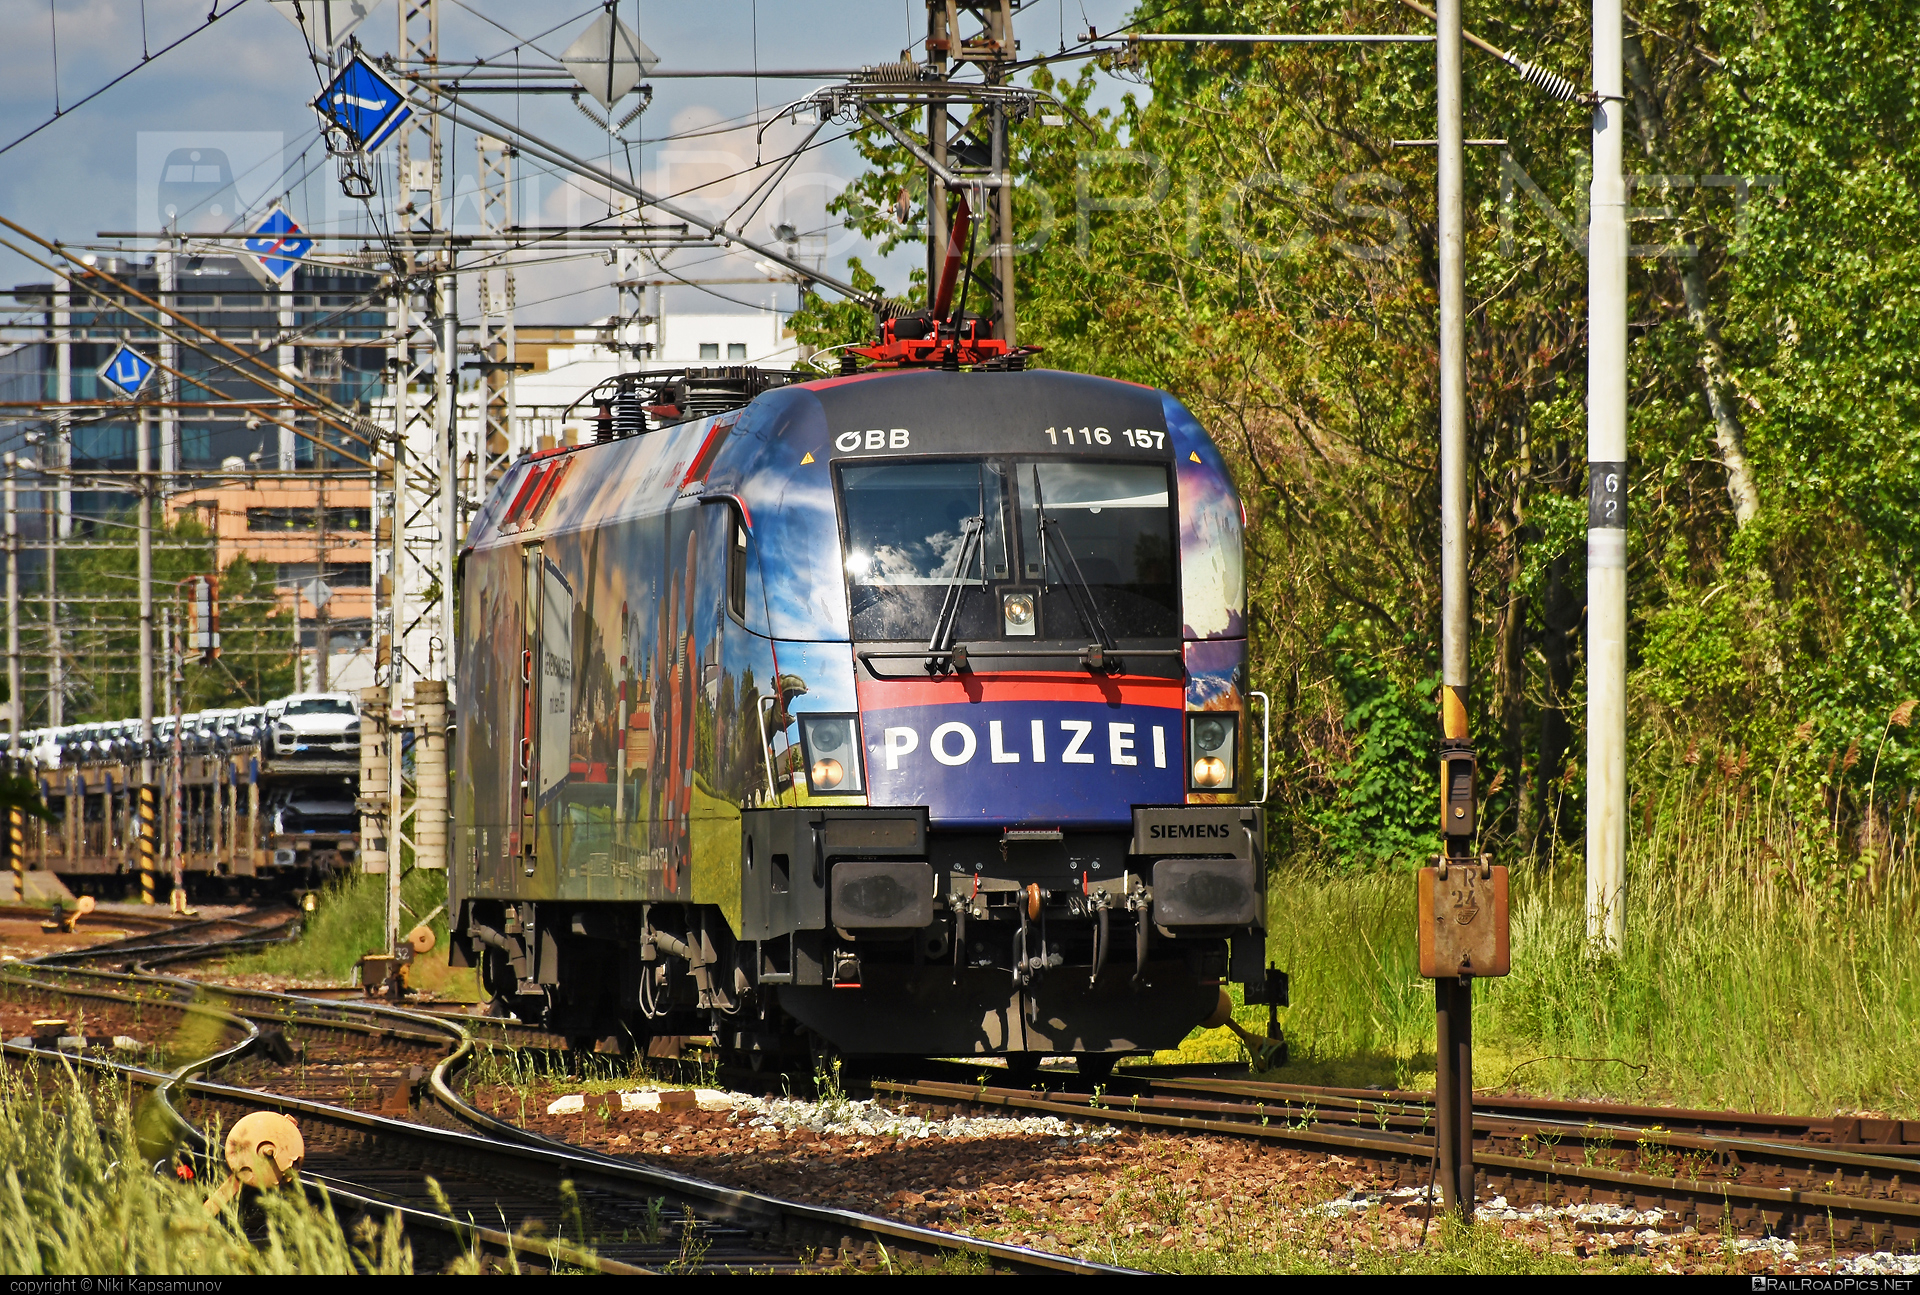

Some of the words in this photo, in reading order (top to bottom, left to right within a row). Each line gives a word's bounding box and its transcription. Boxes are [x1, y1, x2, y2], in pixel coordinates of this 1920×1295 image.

[834, 428, 910, 453] ÖBB
[1044, 426, 1112, 446] 1116
[1122, 427, 1166, 451] 157
[884, 719, 1167, 771] POLIZEI
[1149, 824, 1230, 839] SIEMENS
[1463, 868, 1477, 888] R
[1451, 890, 1477, 909] 24
[395, 946, 410, 961] 32
